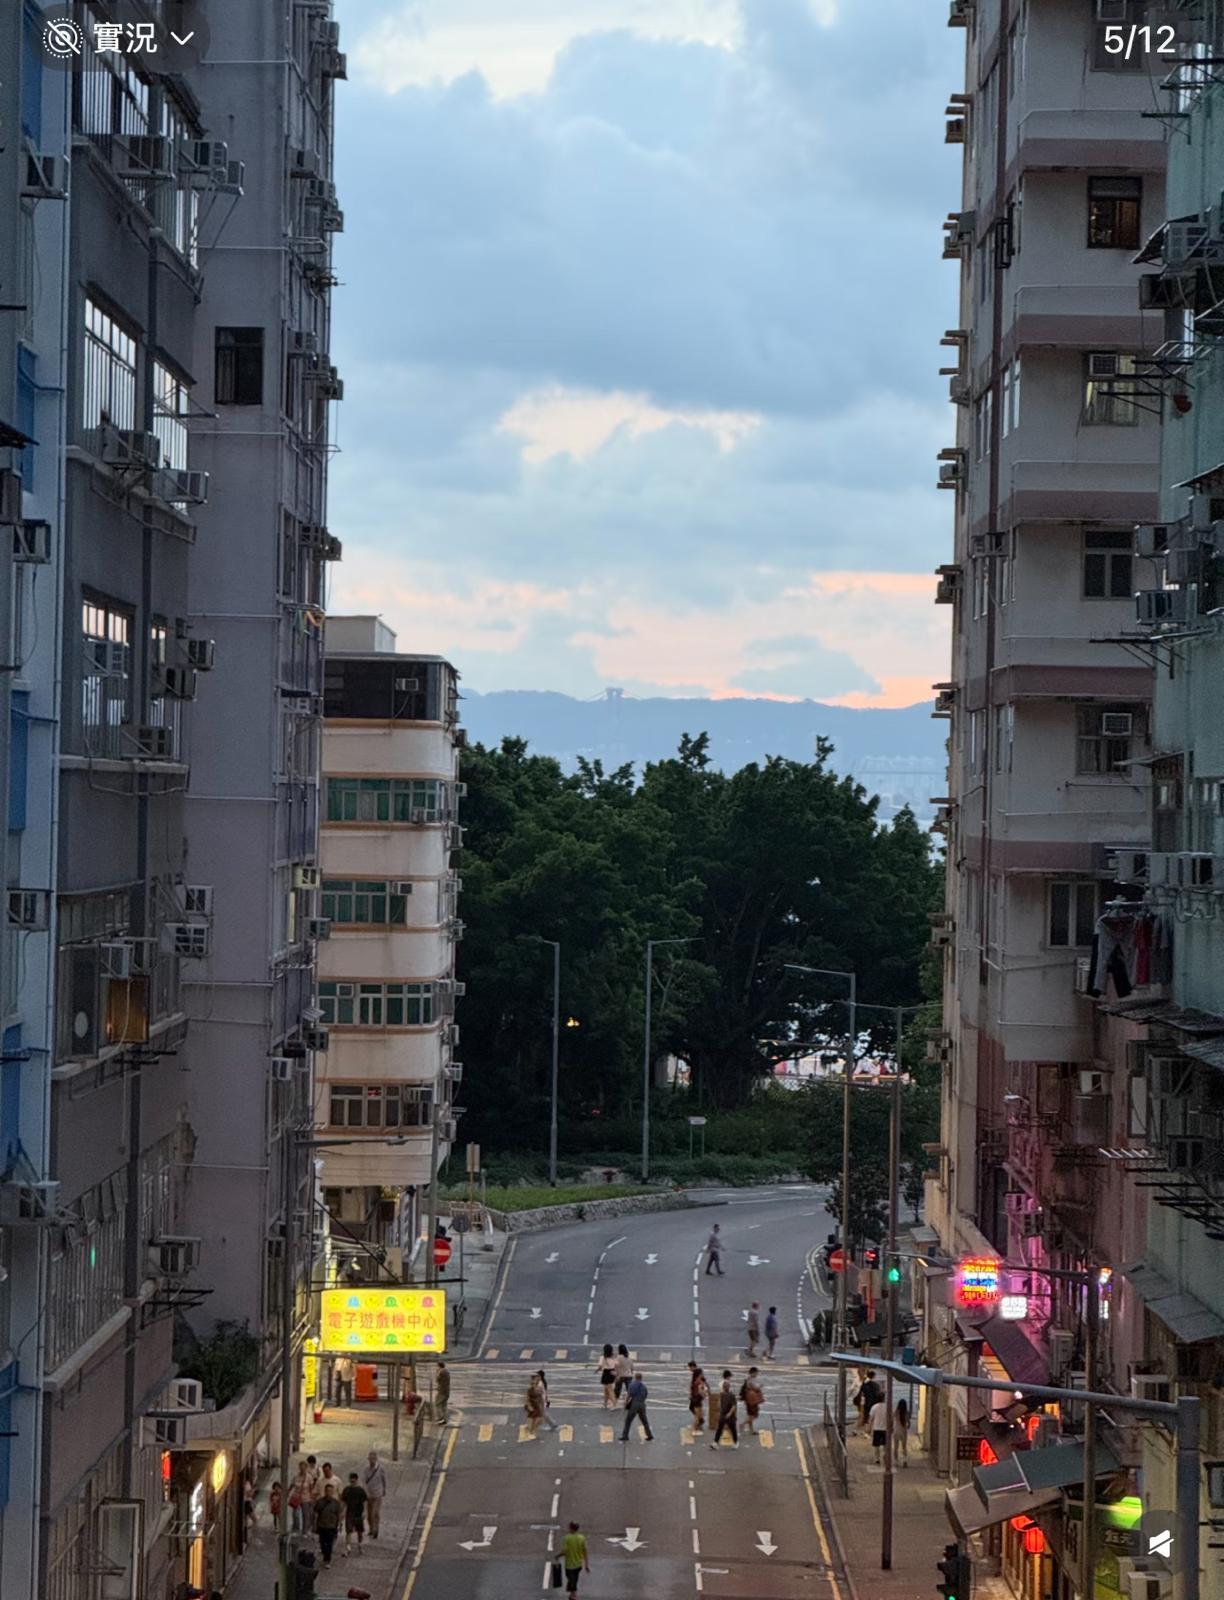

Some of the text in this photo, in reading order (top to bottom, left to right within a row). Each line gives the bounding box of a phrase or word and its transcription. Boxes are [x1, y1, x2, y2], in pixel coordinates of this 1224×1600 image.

[328, 1311, 438, 1329] 電子遊戲機中心
